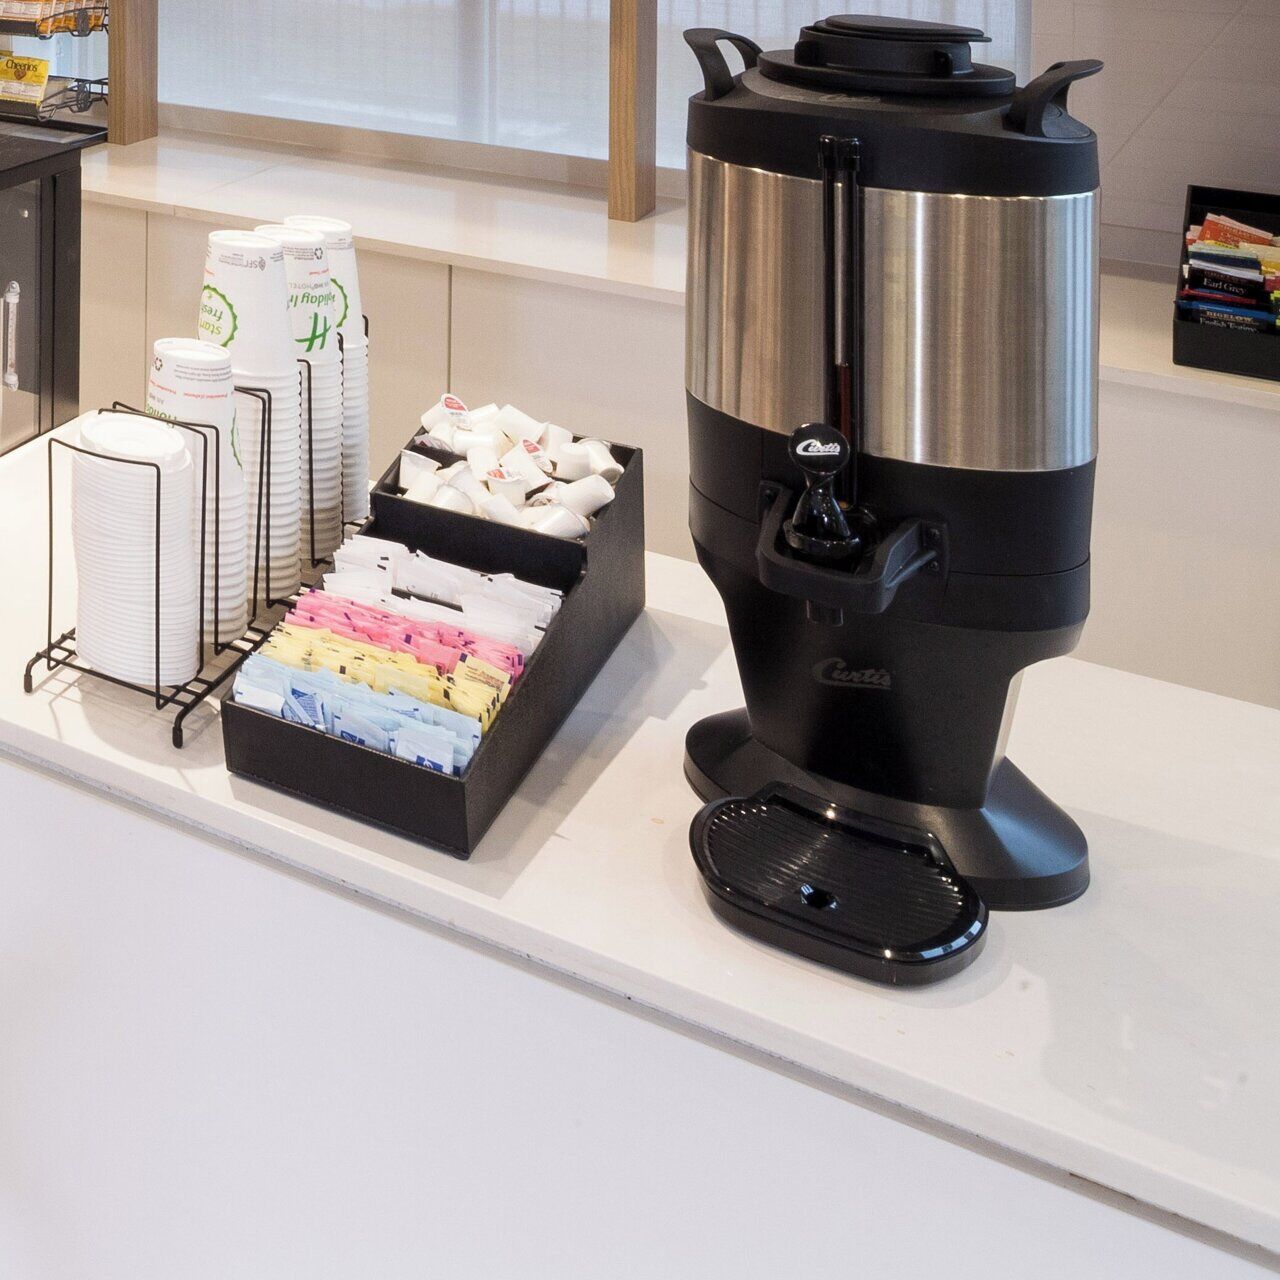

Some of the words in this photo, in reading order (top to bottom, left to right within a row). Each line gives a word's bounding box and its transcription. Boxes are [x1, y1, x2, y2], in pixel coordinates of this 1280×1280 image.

[6, 58, 38, 71] Cheerios
[1203, 278, 1222, 289] Earl
[1224, 282, 1247, 294] Grey
